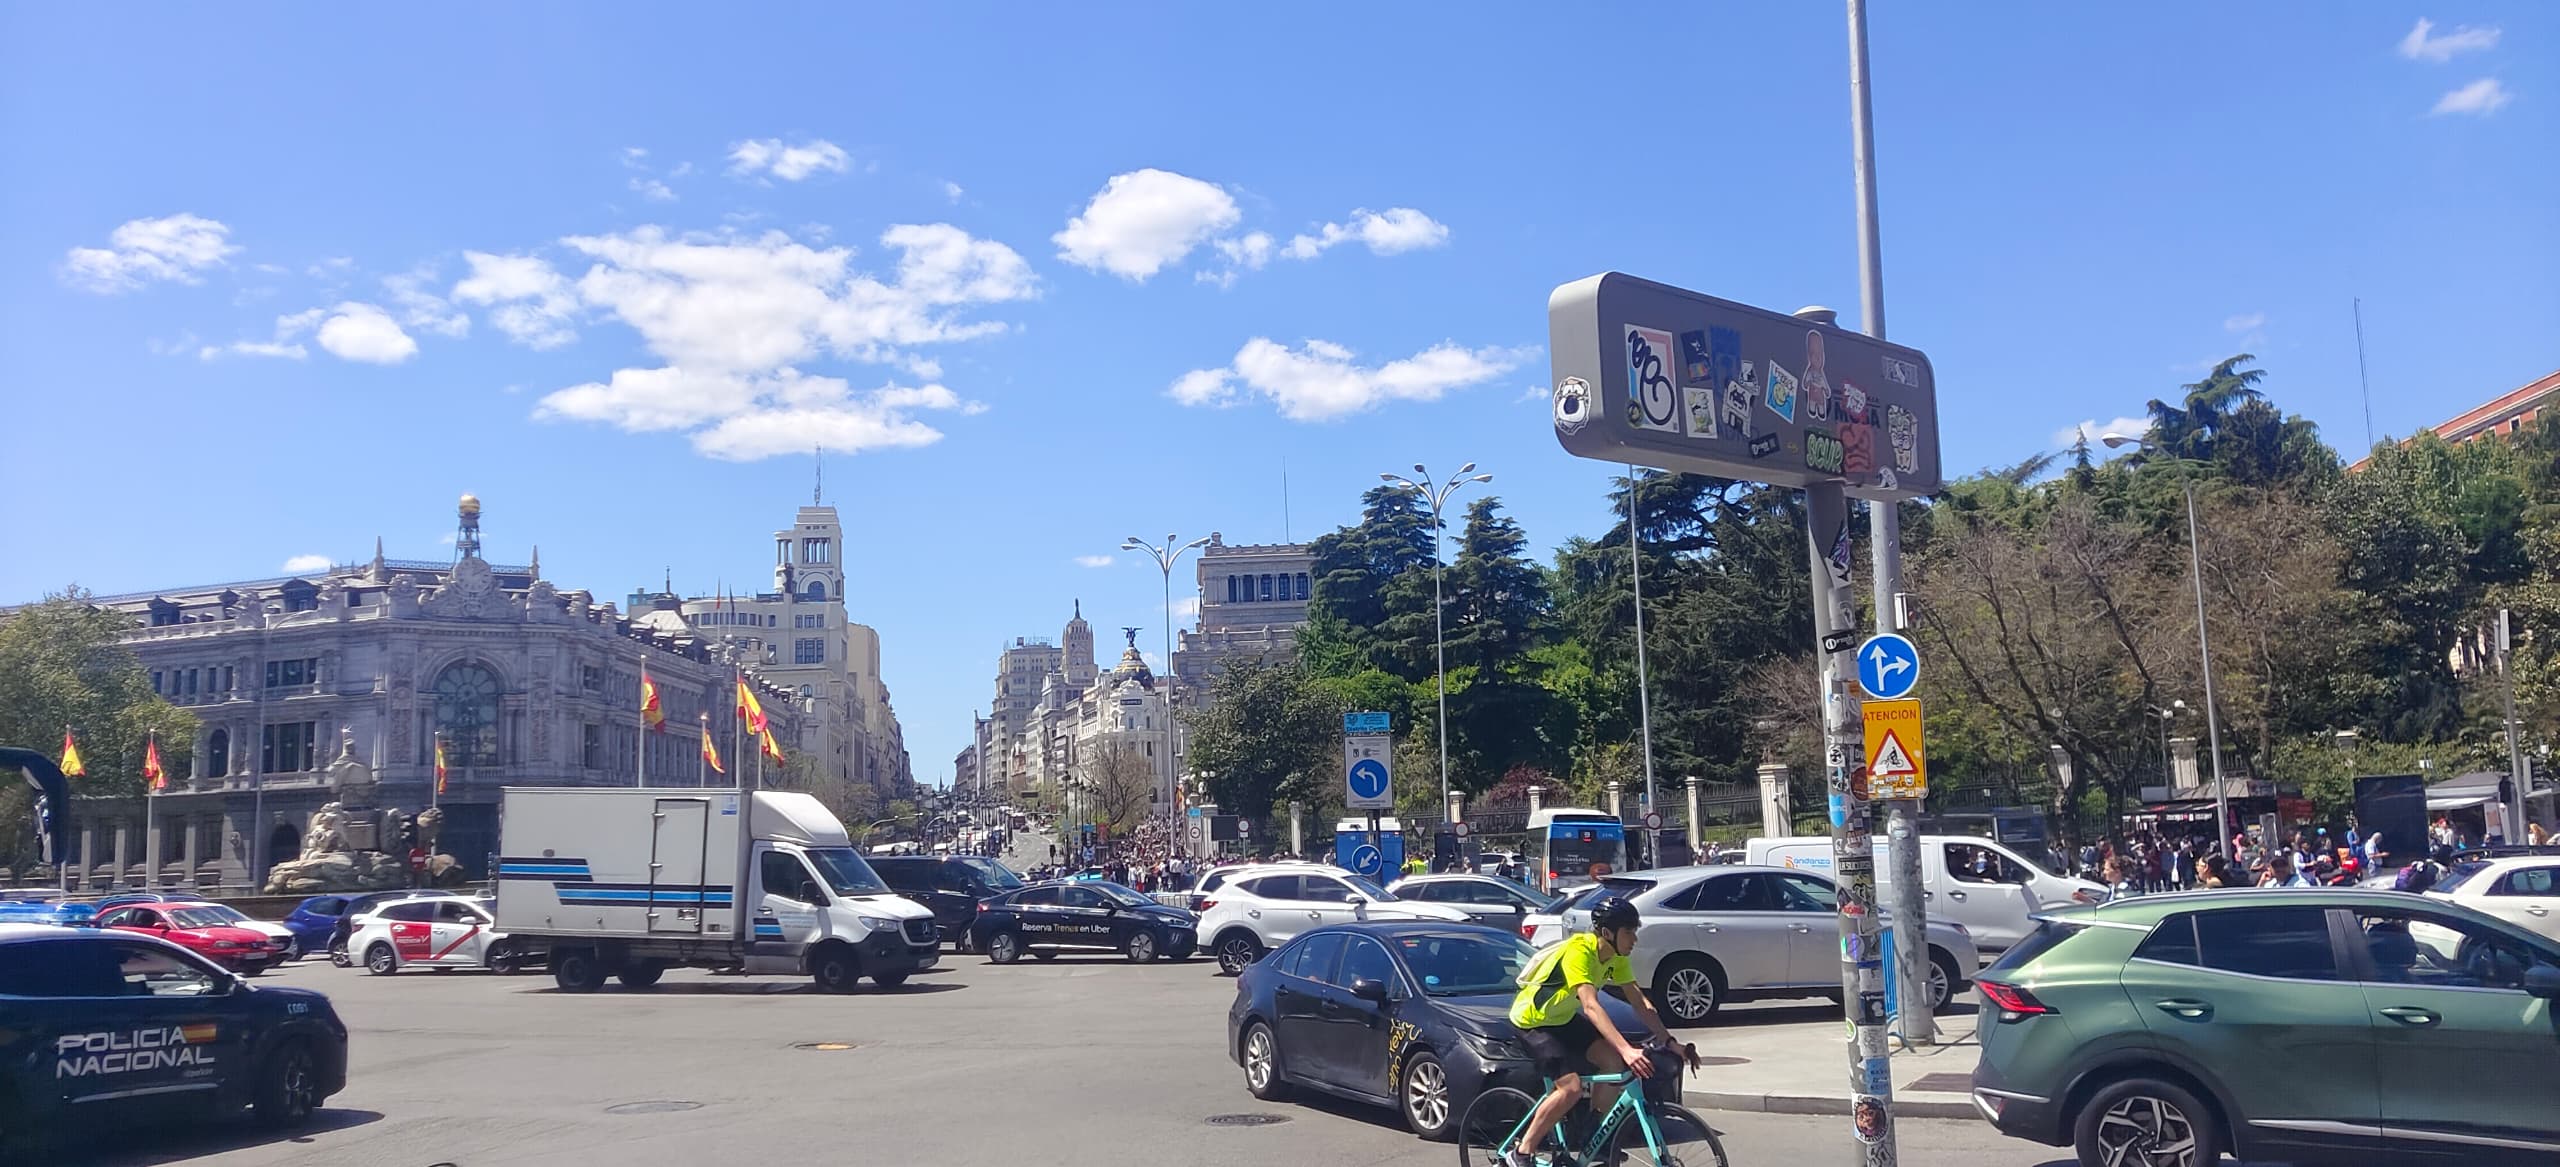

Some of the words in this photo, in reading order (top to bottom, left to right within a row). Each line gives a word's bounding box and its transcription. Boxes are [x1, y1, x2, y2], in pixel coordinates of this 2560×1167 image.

[1022, 922, 1052, 933] Reserva
[1080, 925, 1090, 933] en
[1091, 923, 1111, 934] Uber
[56, 1047, 216, 1079] NACIONAL
[1584, 1101, 1626, 1158] Bianchi
